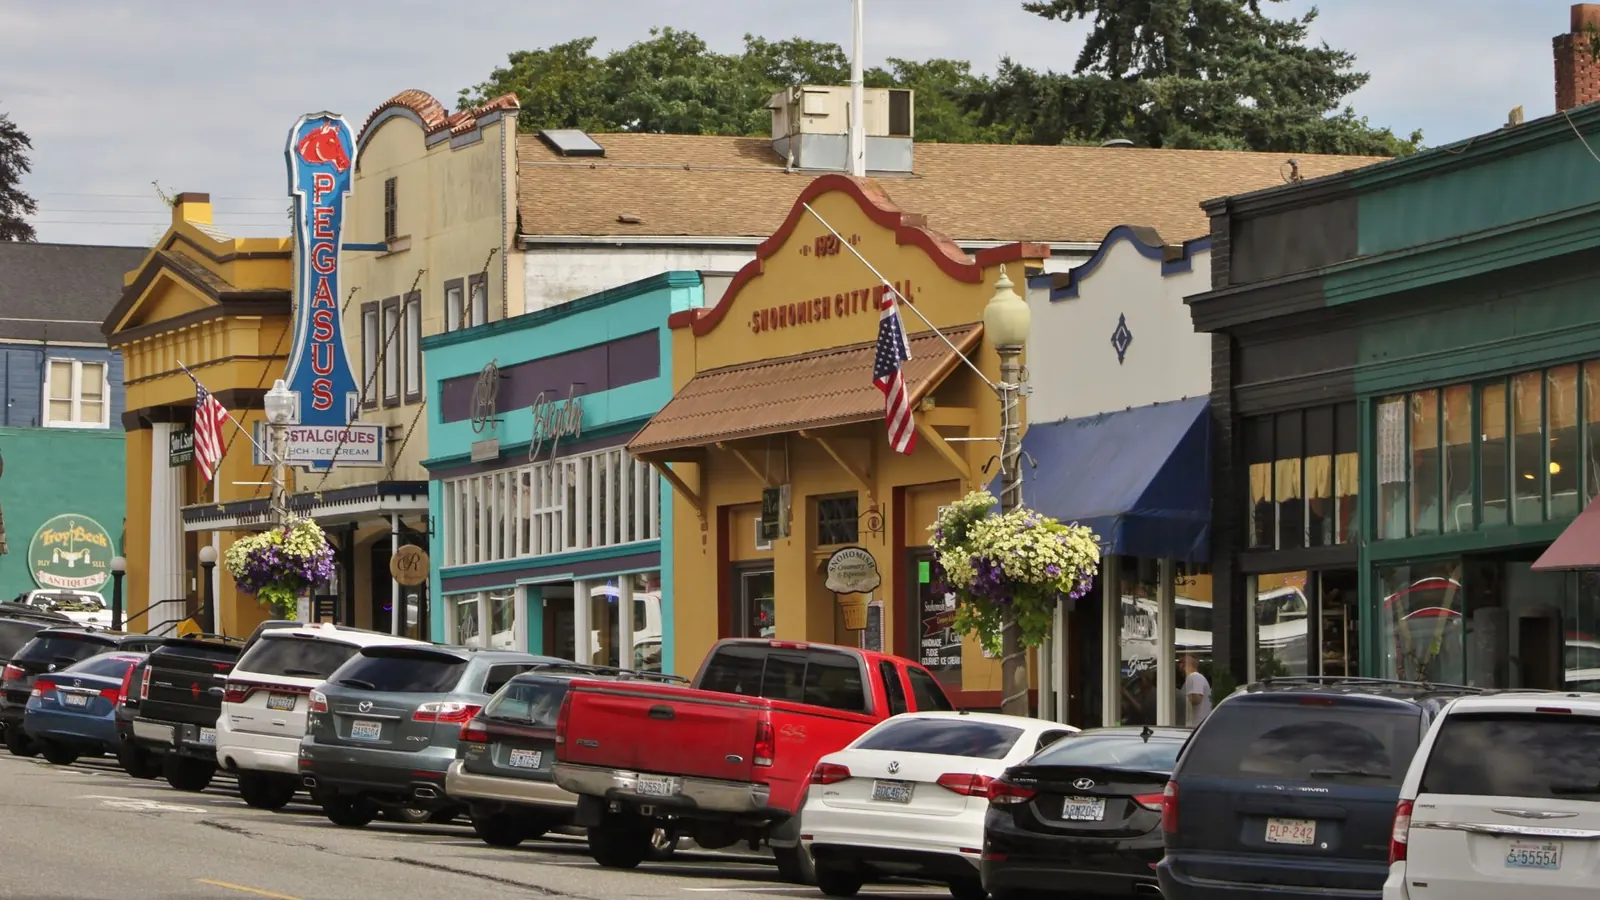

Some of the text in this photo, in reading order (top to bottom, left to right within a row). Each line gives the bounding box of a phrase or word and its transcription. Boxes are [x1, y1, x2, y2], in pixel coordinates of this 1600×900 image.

[311, 172, 336, 411] PEGASUS
[752, 280, 914, 334] SNOHOMISH CITY HLL
[270, 429, 375, 444] OSTALGIQUES
[335, 448, 369, 456] CREAM
[40, 526, 107, 547] Troy Beck
[829, 550, 875, 573] SNOHOMISH
[47, 576, 97, 588] ANTIQUES
